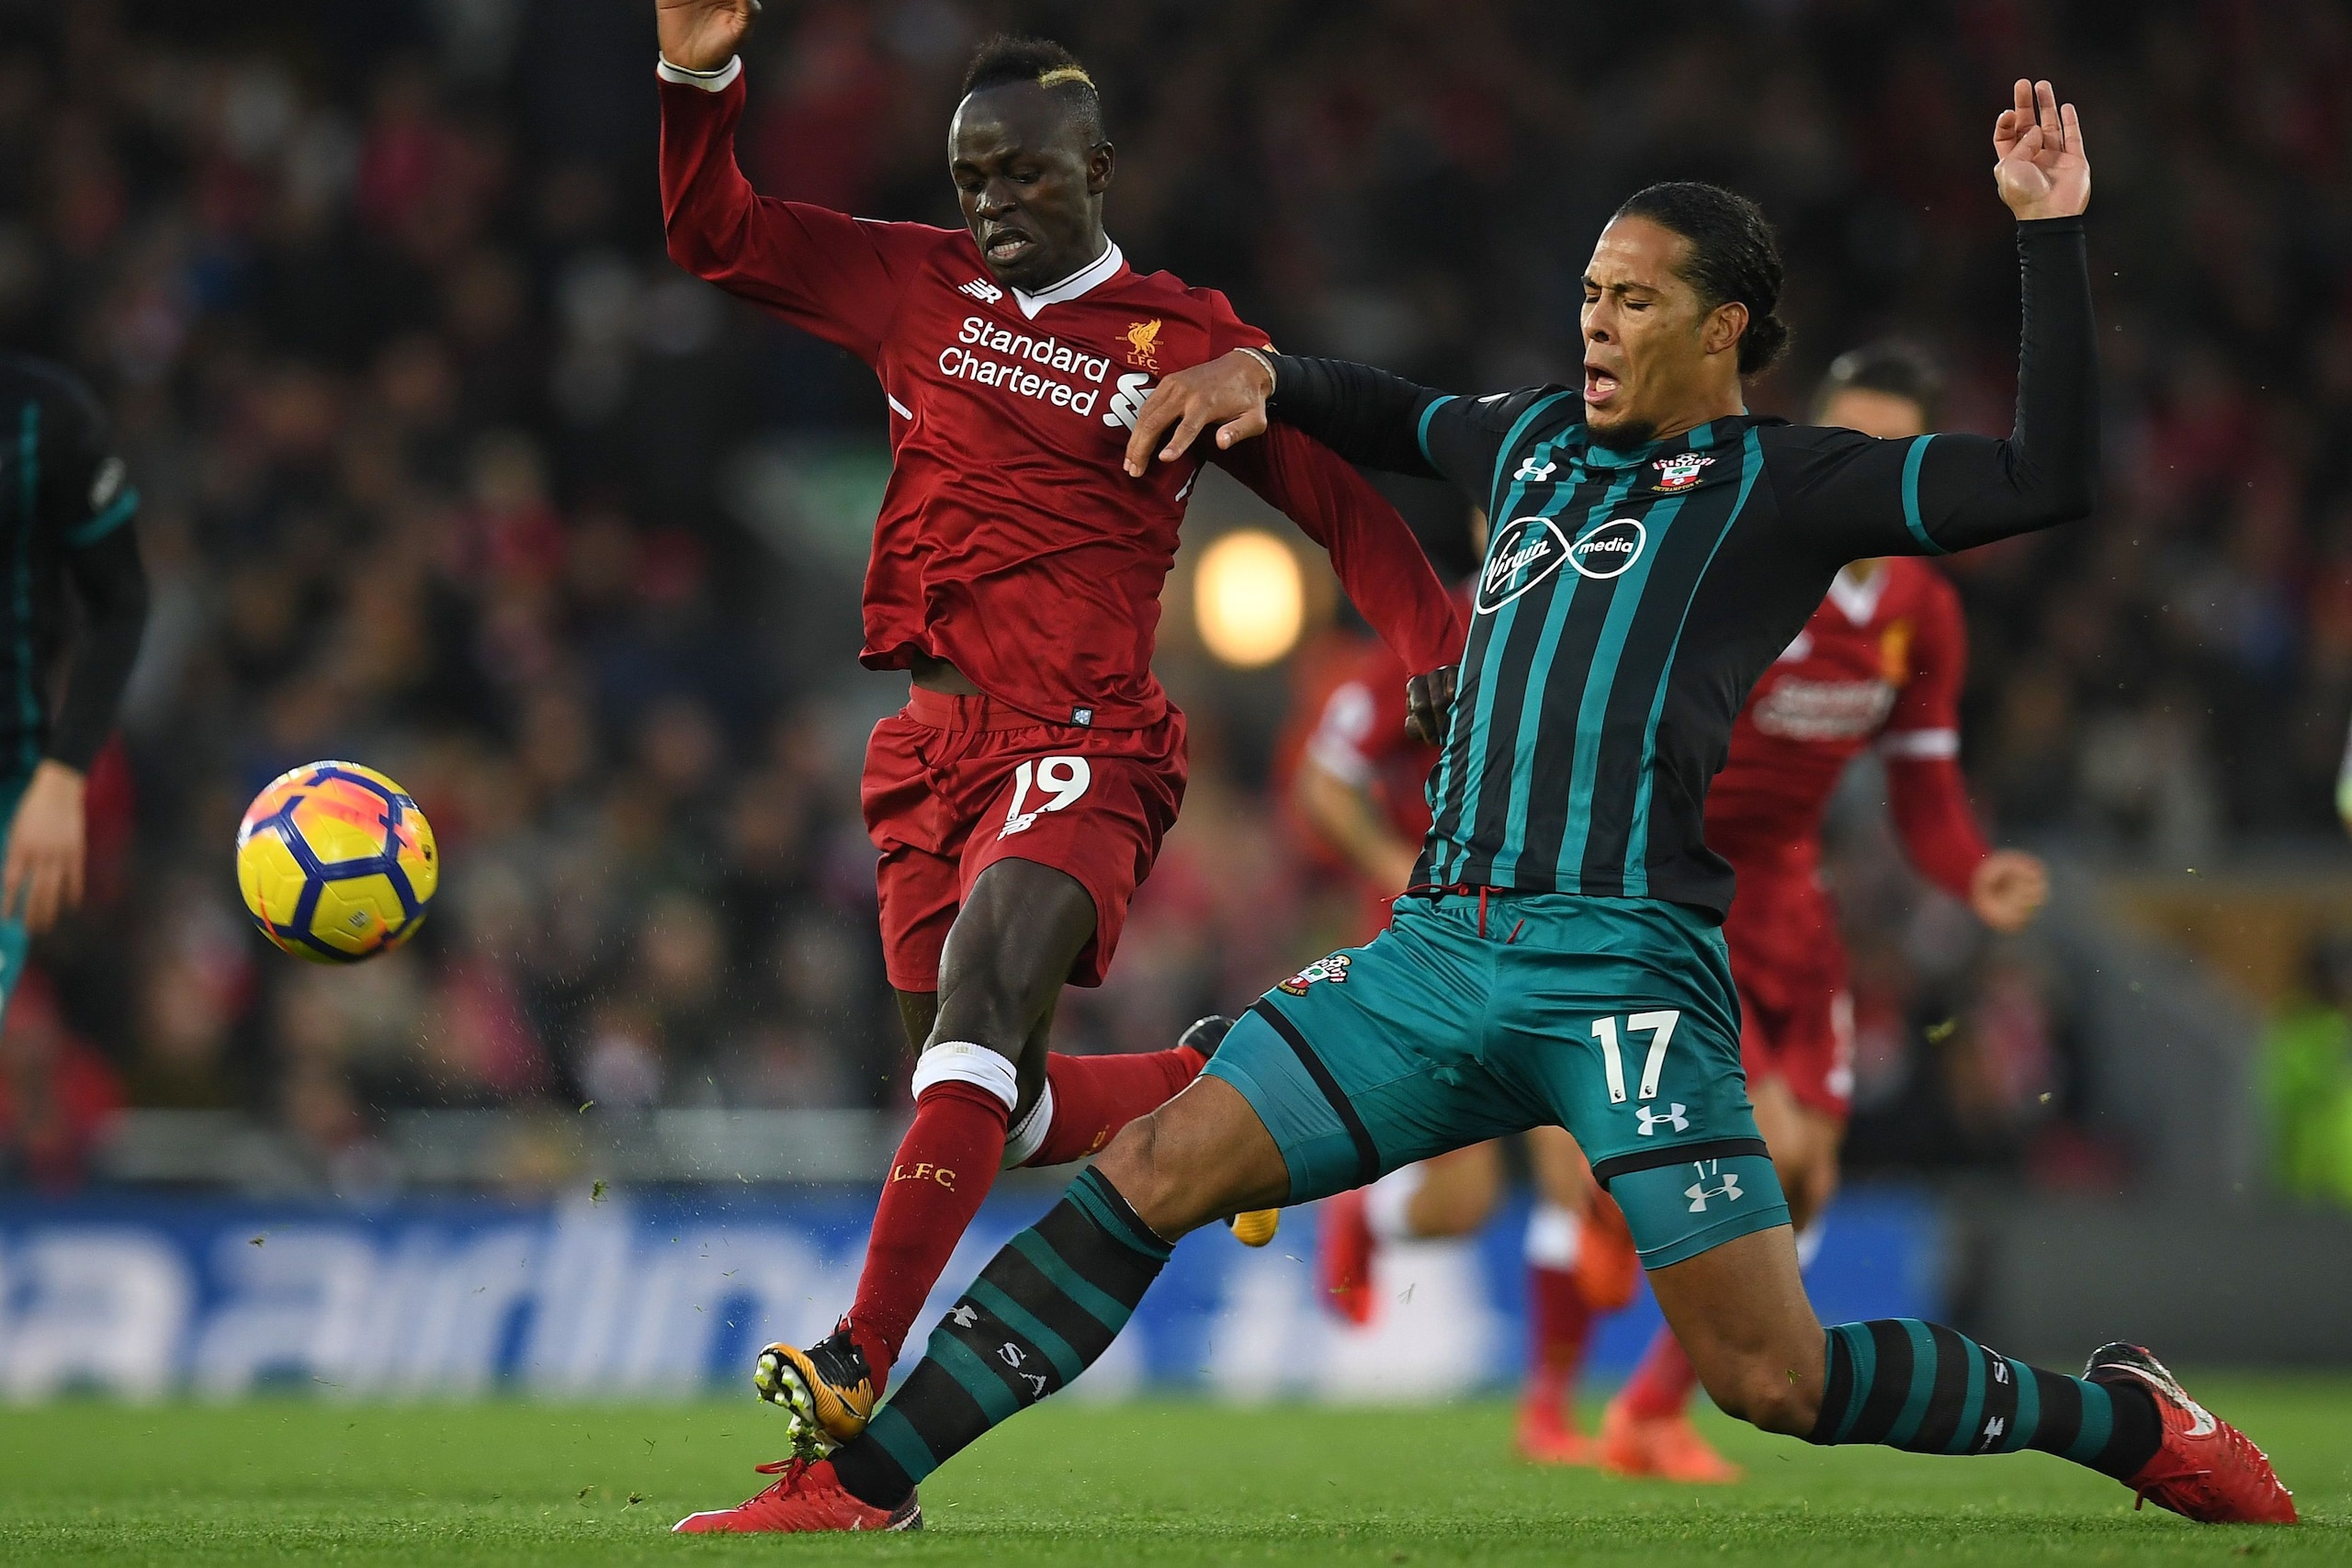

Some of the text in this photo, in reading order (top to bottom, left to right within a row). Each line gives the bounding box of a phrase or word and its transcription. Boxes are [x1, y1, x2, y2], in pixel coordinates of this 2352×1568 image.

[938, 346, 1100, 417] Chartered
[957, 316, 1111, 384] Standard
[1485, 531, 1634, 594] Virgin media
[1007, 756, 1091, 821] 19
[1591, 1010, 1680, 1104] 17
